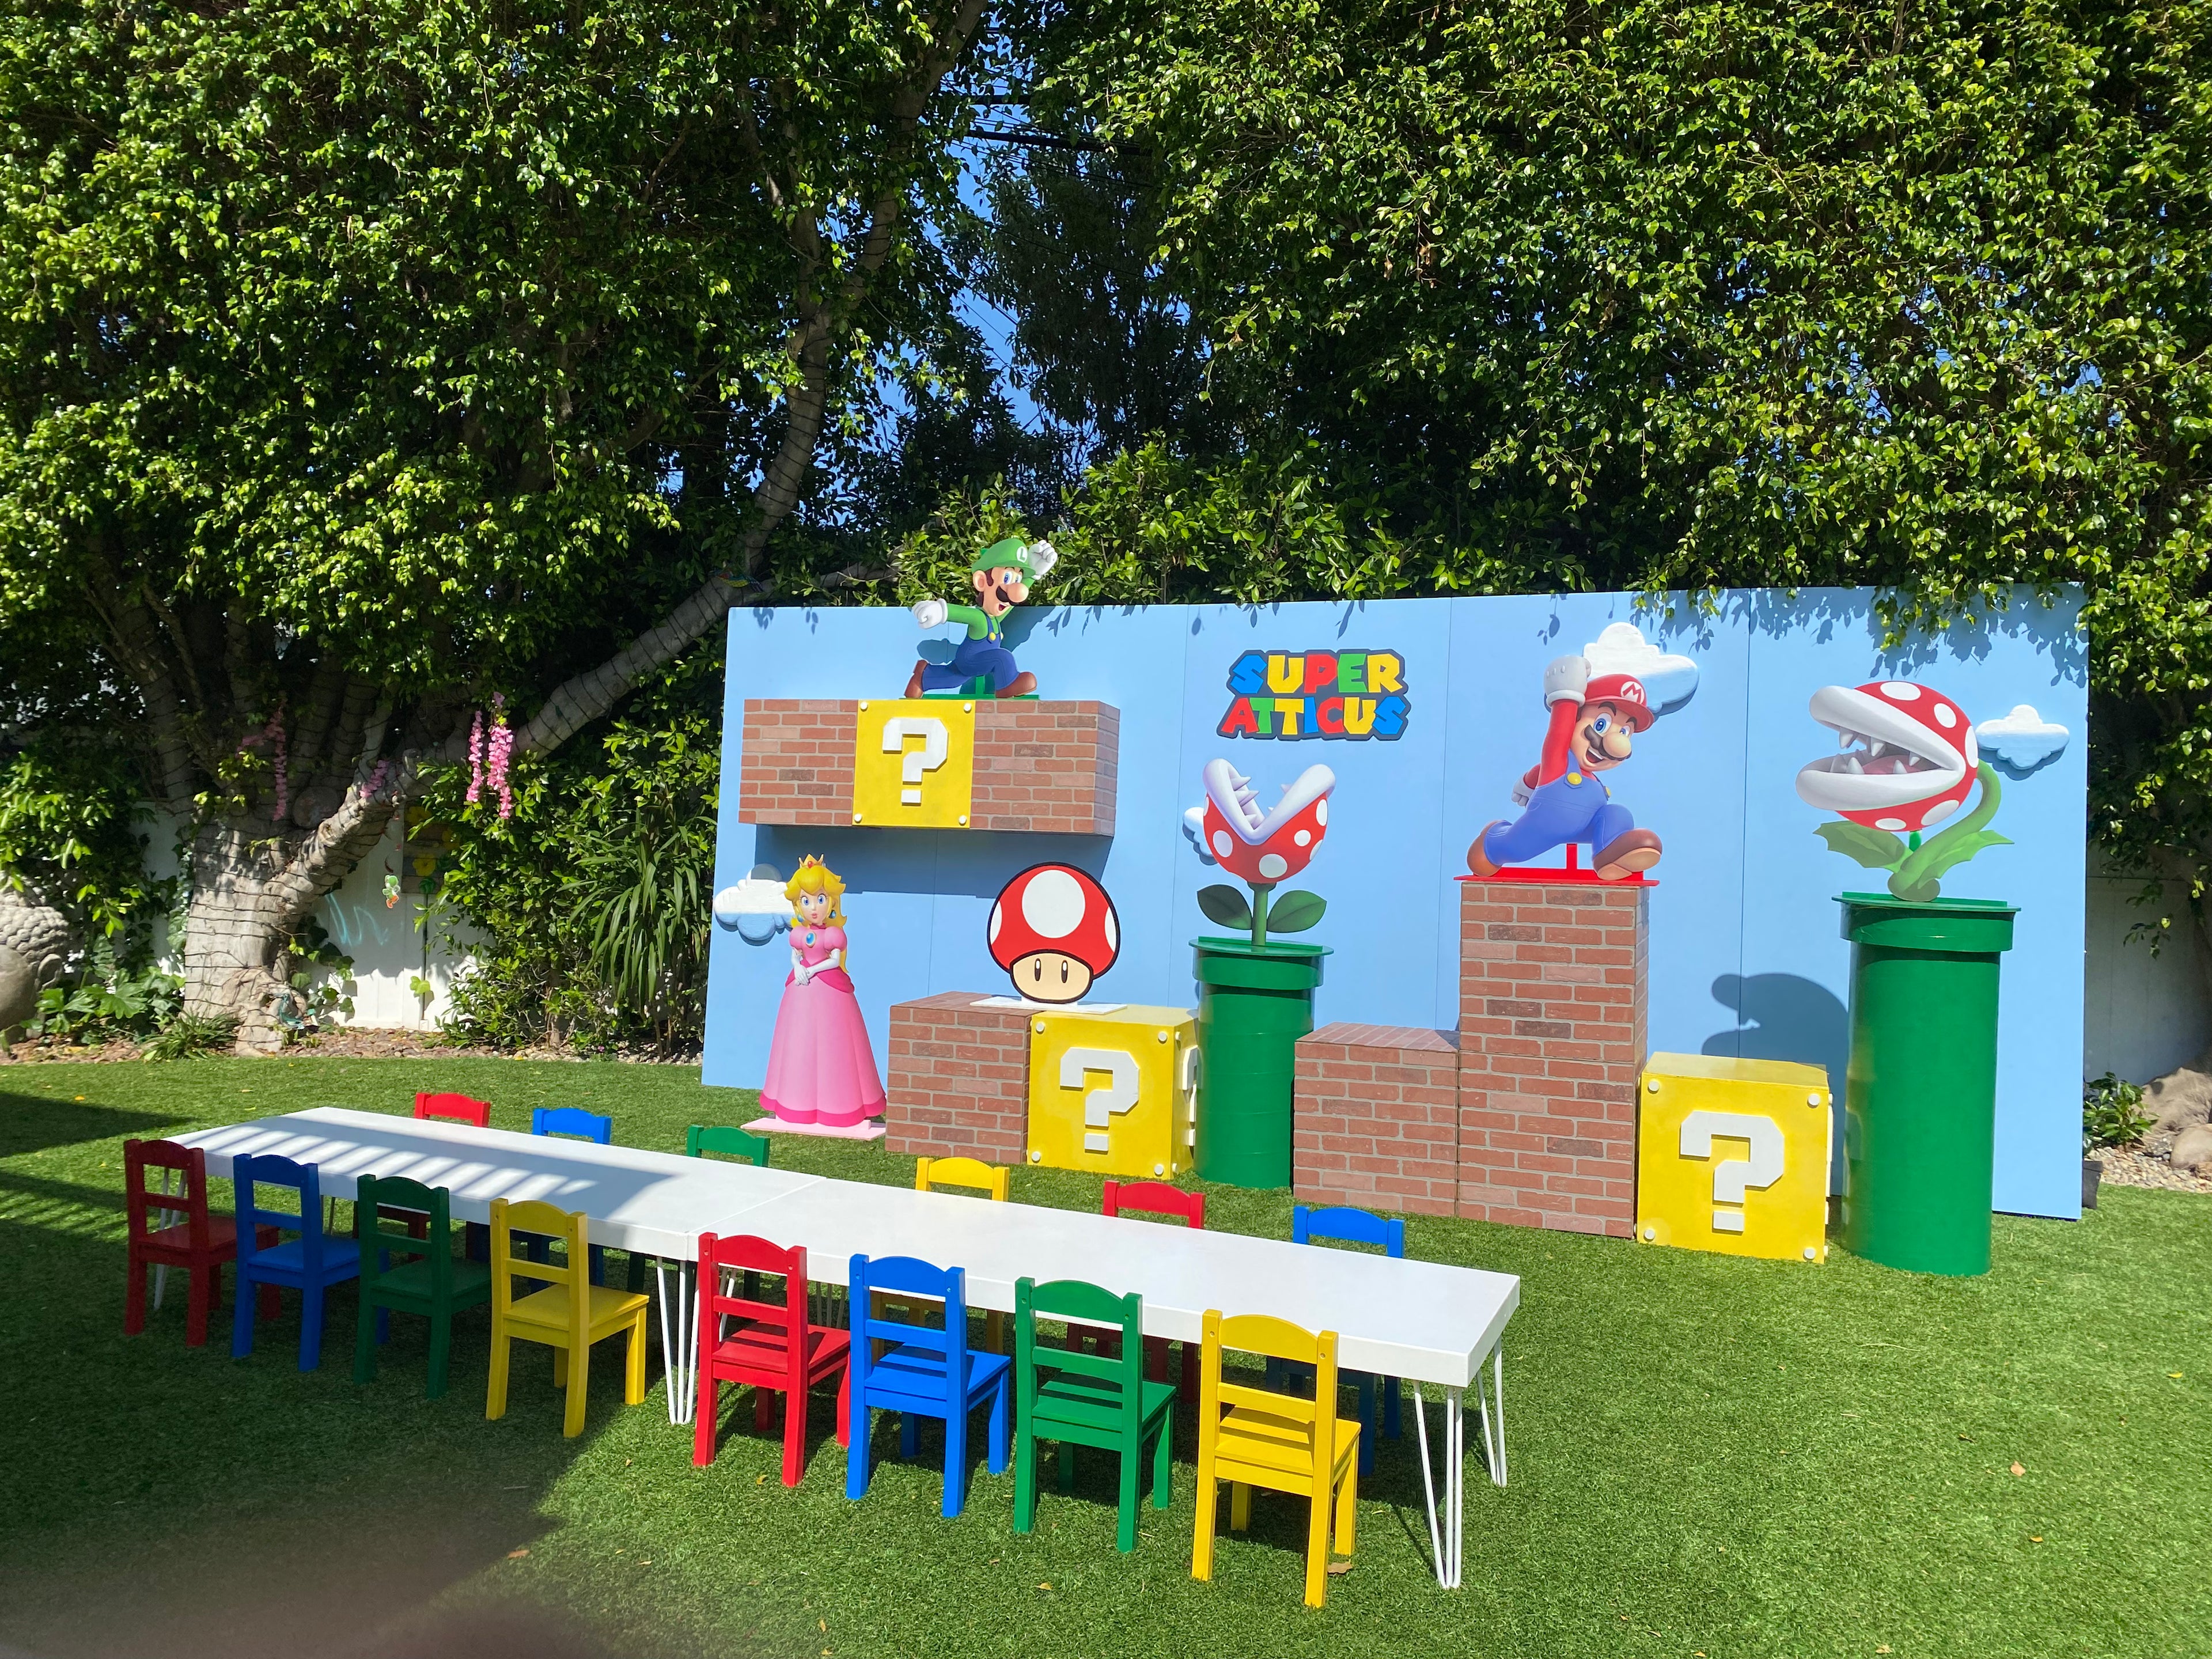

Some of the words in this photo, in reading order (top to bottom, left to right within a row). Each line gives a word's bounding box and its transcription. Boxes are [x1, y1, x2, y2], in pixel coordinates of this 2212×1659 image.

[1230, 653, 1403, 694] SUPER
[1622, 683, 1642, 703] M
[1221, 696, 1407, 735] ATTICUS
